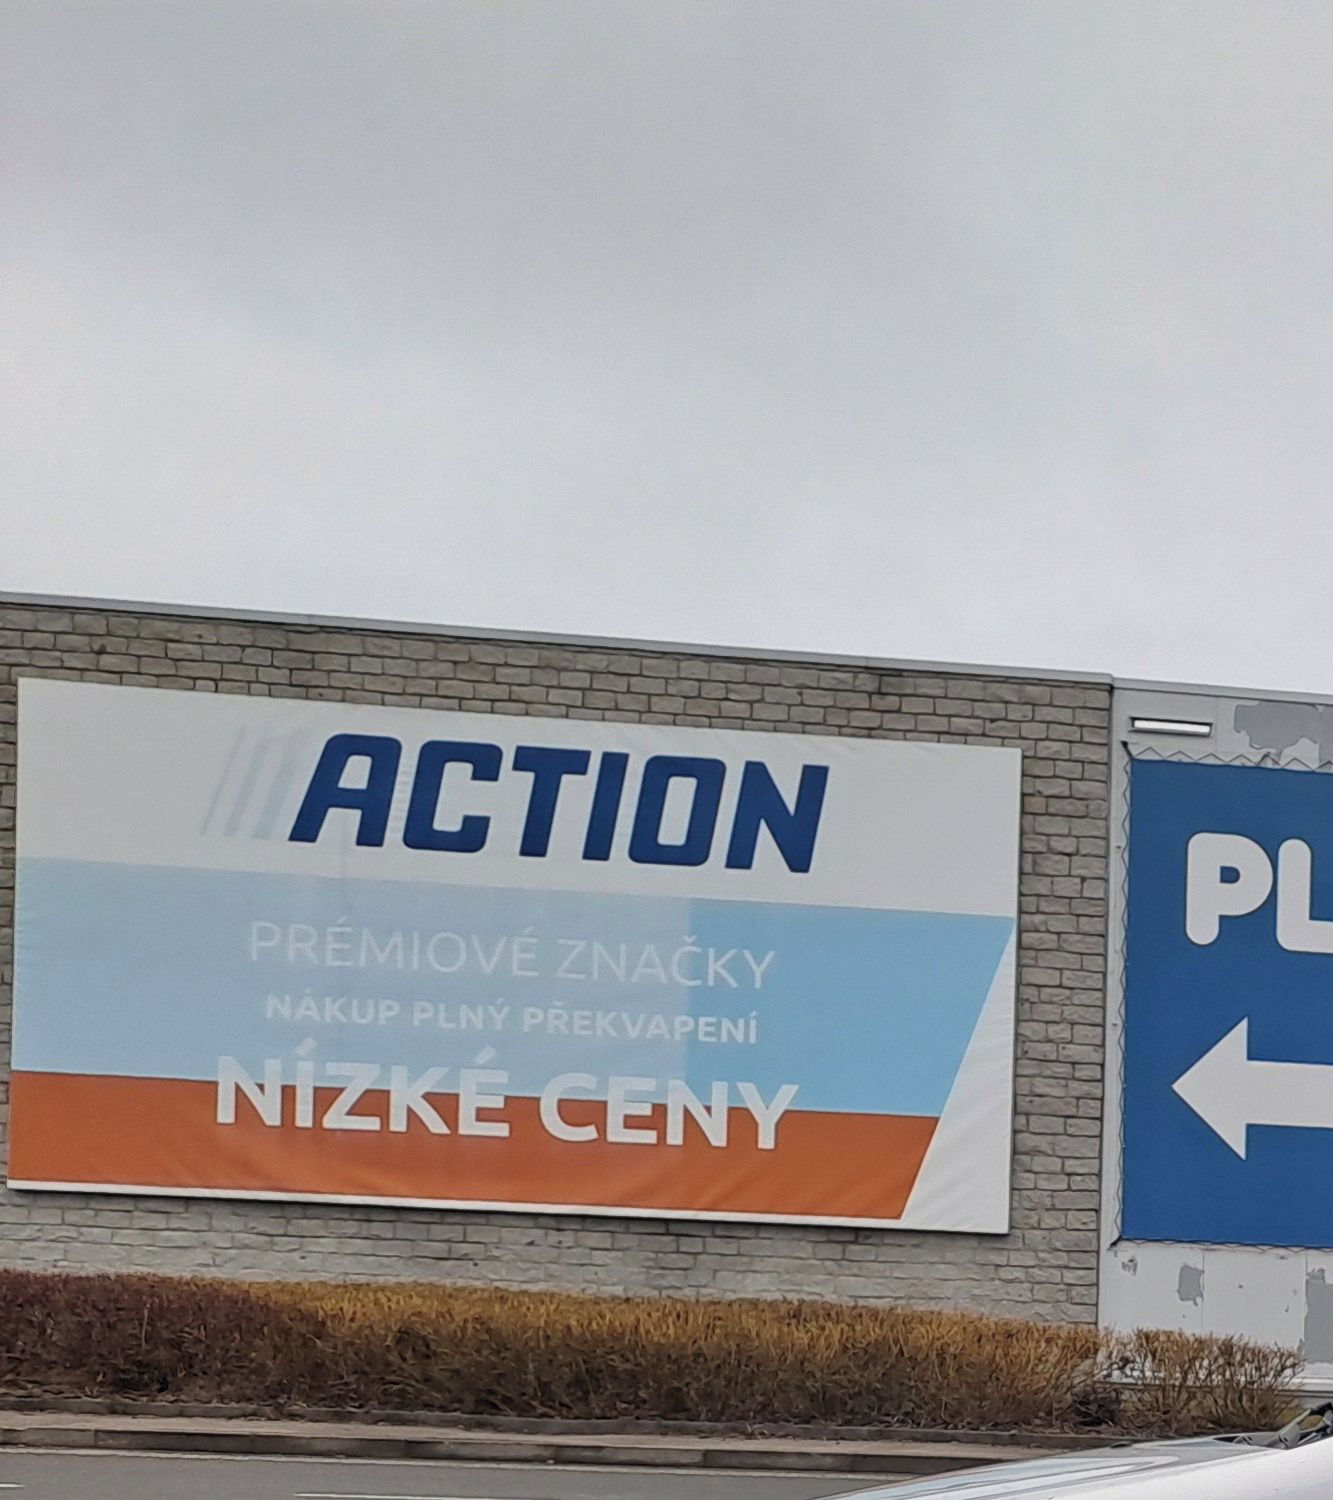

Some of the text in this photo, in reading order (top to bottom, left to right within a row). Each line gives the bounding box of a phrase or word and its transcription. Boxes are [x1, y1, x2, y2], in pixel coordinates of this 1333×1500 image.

[287, 733, 829, 874] ACTION
[250, 915, 775, 989] PRÉMIOVÉ ZNAČKY
[266, 988, 758, 1044] NÁKUP PLNÝ PŘEKVAPENÍ
[215, 1037, 799, 1150] NÍZKÉ CENY
